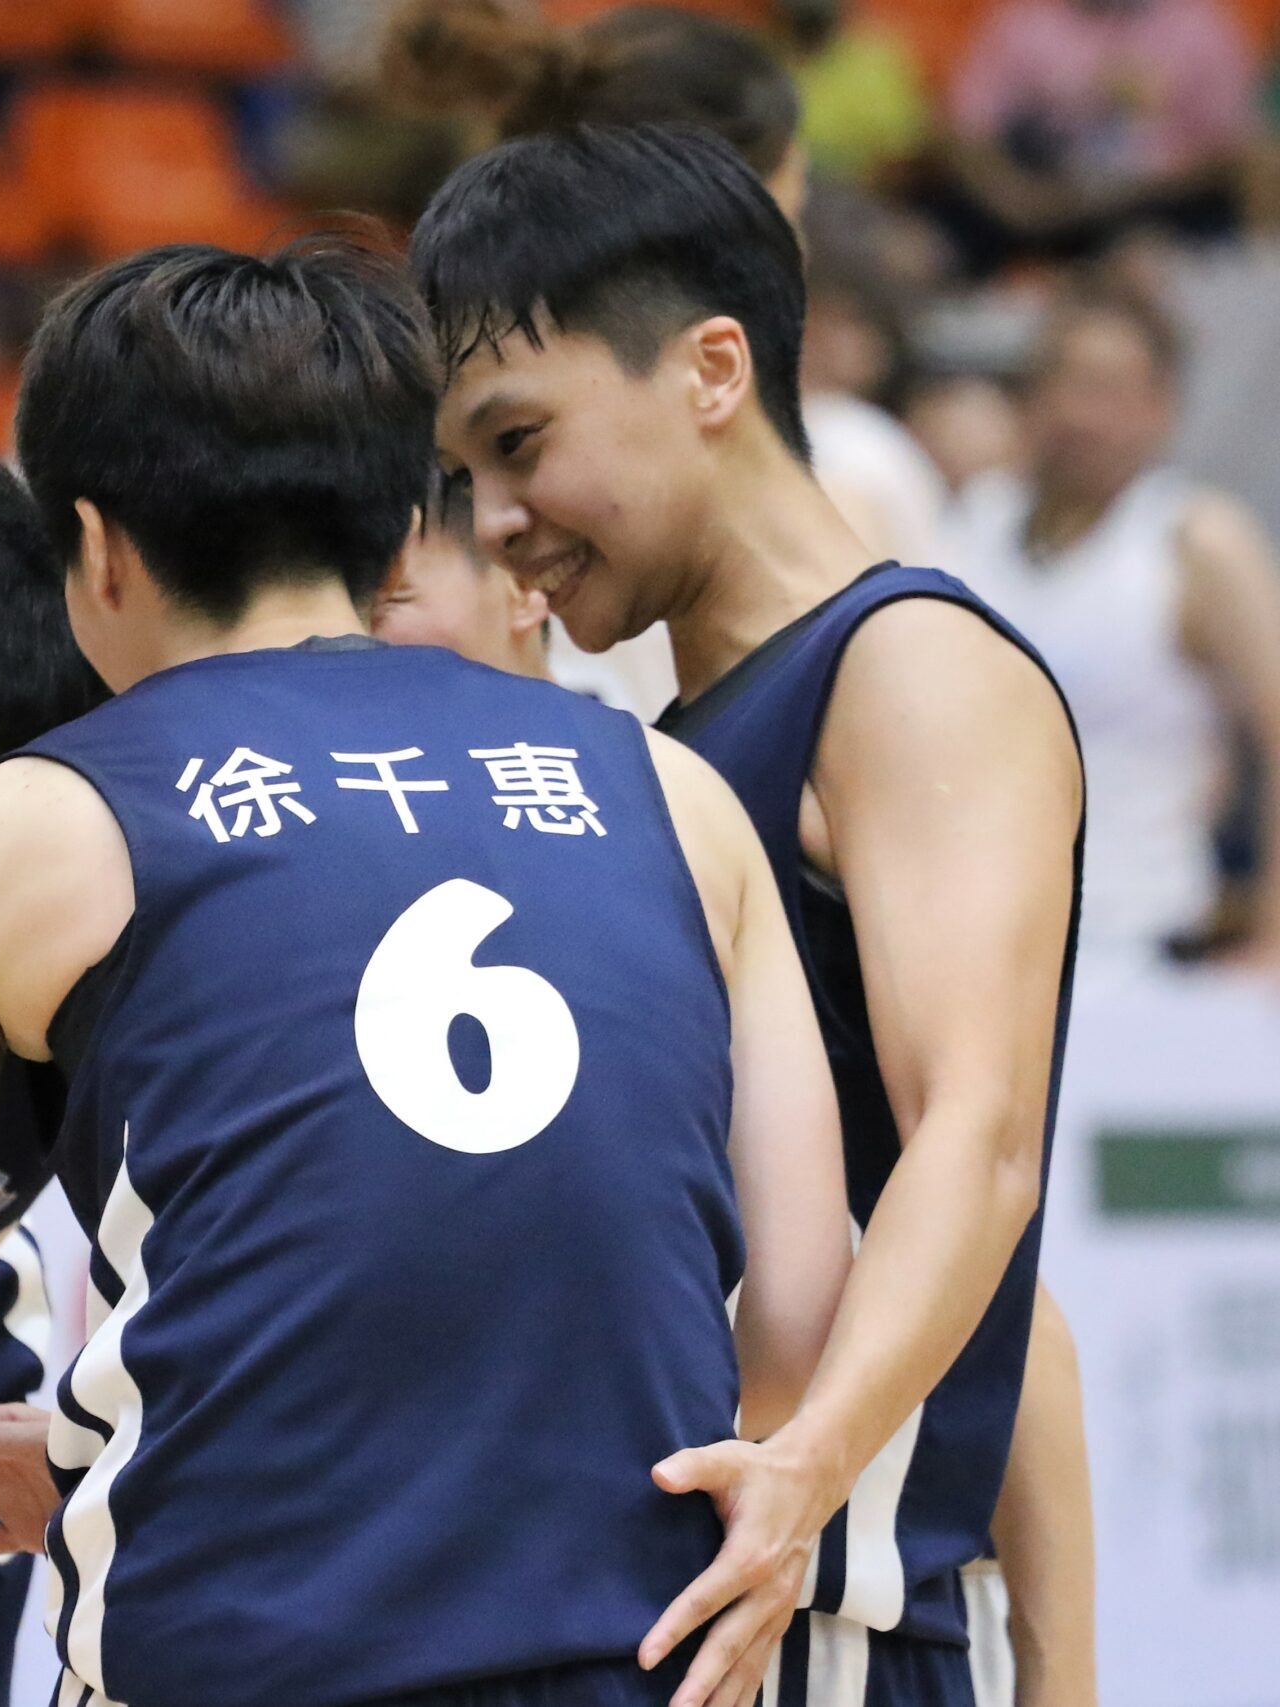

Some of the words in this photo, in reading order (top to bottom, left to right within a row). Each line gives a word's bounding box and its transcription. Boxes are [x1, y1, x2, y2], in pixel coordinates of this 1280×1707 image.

[175, 742, 608, 843] 徐千惠
[354, 877, 580, 1155] 6
